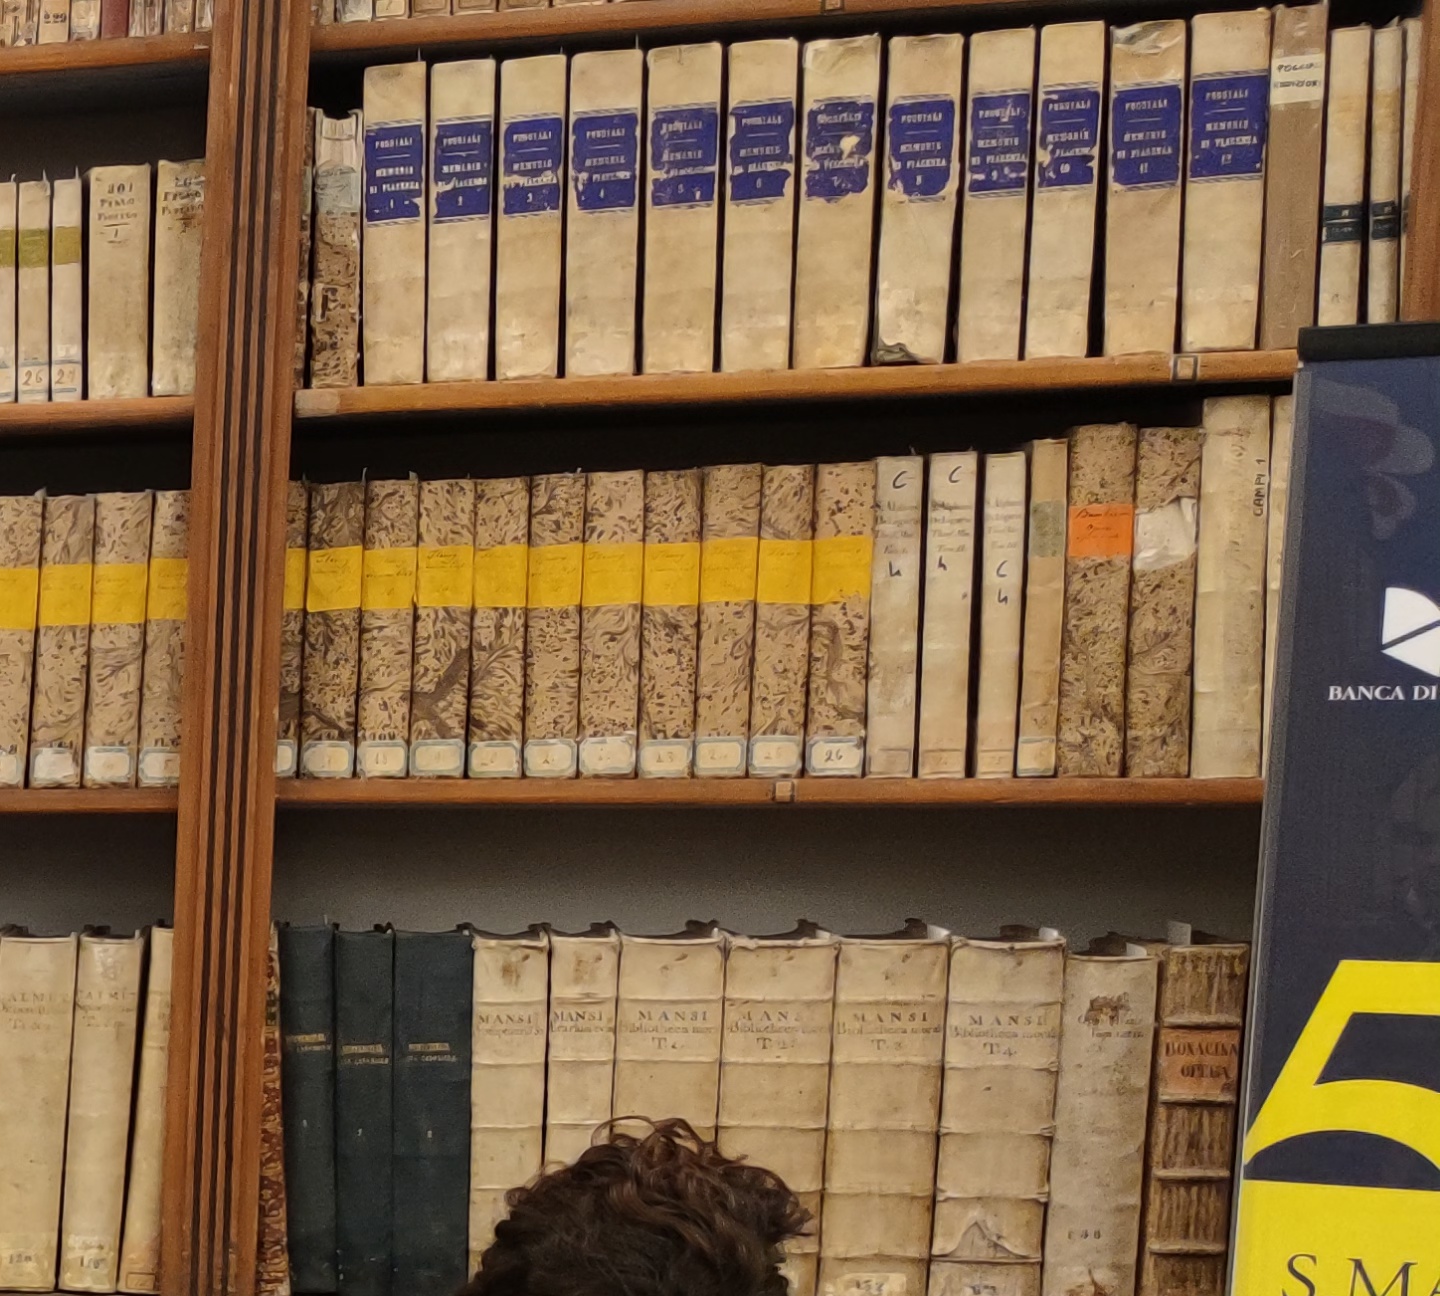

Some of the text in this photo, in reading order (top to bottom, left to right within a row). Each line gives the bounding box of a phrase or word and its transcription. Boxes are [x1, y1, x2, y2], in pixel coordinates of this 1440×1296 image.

[1328, 685, 1437, 700] BANCA DI
[638, 1011, 707, 1021] MANSI
